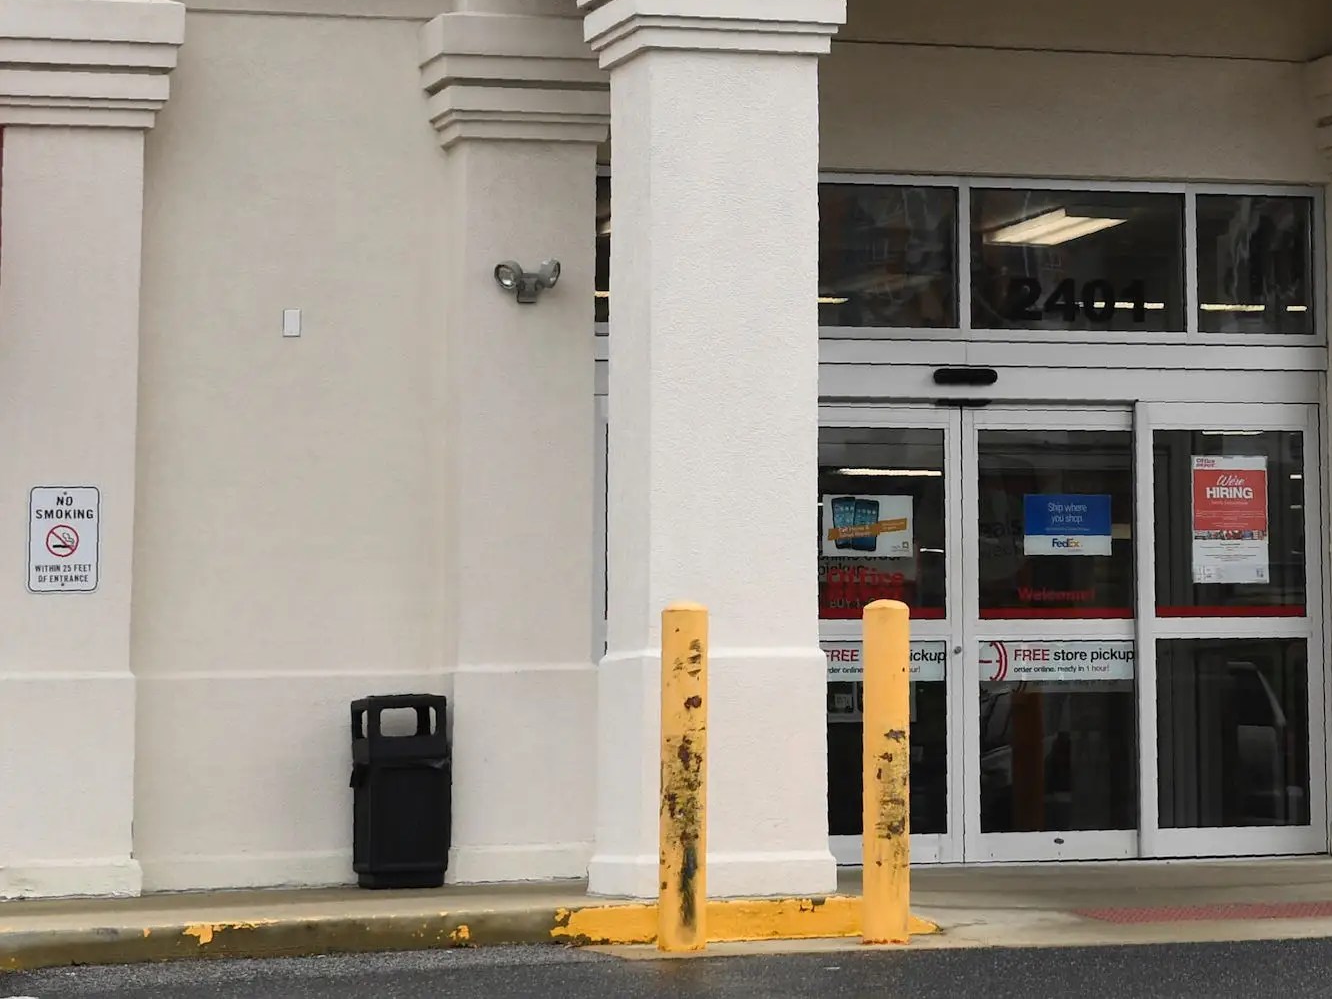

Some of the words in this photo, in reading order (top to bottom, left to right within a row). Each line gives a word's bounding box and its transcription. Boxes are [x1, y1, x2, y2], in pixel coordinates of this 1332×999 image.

[1007, 277, 1145, 322] 2401
[1206, 487, 1253, 499] HIRING
[56, 496, 73, 506] NO
[1048, 502, 1063, 513] Ship
[1064, 502, 1087, 512] where
[36, 509, 94, 519] SMOKING
[1051, 515, 1064, 524] you
[1052, 538, 1080, 548] FedEx
[35, 564, 60, 572] WITHIN
[63, 564, 71, 572] 25
[74, 564, 92, 572] FEET
[38, 575, 47, 583] OF
[50, 575, 88, 583] ENTRANCE
[910, 649, 946, 663] ickup
[1014, 649, 1049, 661] FREE
[1053, 650, 1087, 661] store
[1091, 648, 1134, 663] pickup
[1014, 665, 1032, 673] order
[1057, 665, 1076, 673] ready
